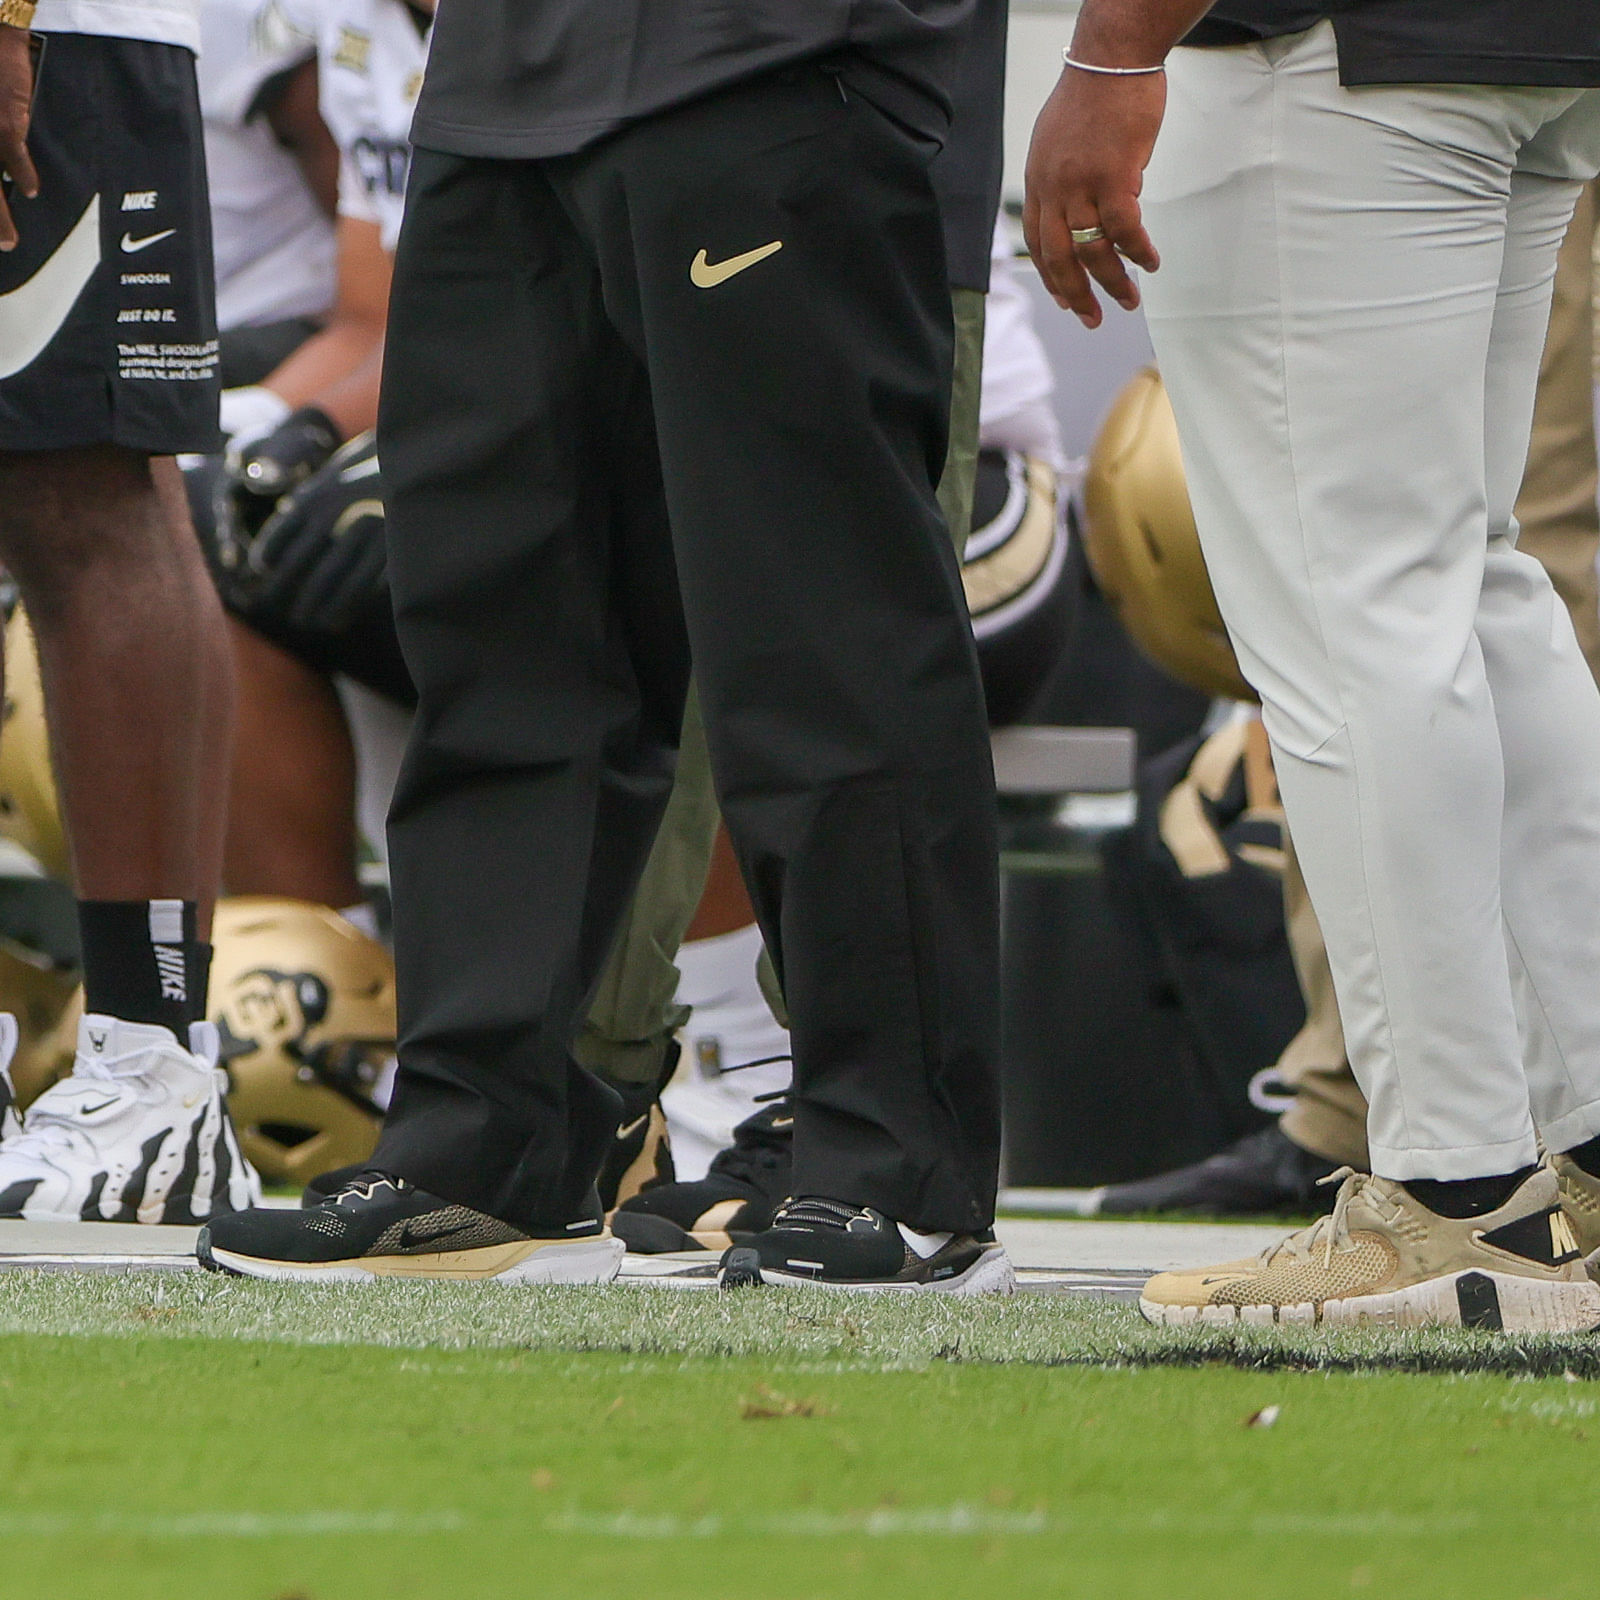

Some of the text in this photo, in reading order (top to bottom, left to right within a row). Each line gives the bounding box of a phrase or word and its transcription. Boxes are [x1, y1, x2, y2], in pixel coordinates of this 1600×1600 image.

[120, 190, 159, 211] NIKE
[120, 273, 171, 285] SWOOSH
[116, 309, 142, 323] JUST
[143, 309, 161, 322] DO
[152, 945, 188, 1003] NIKE
